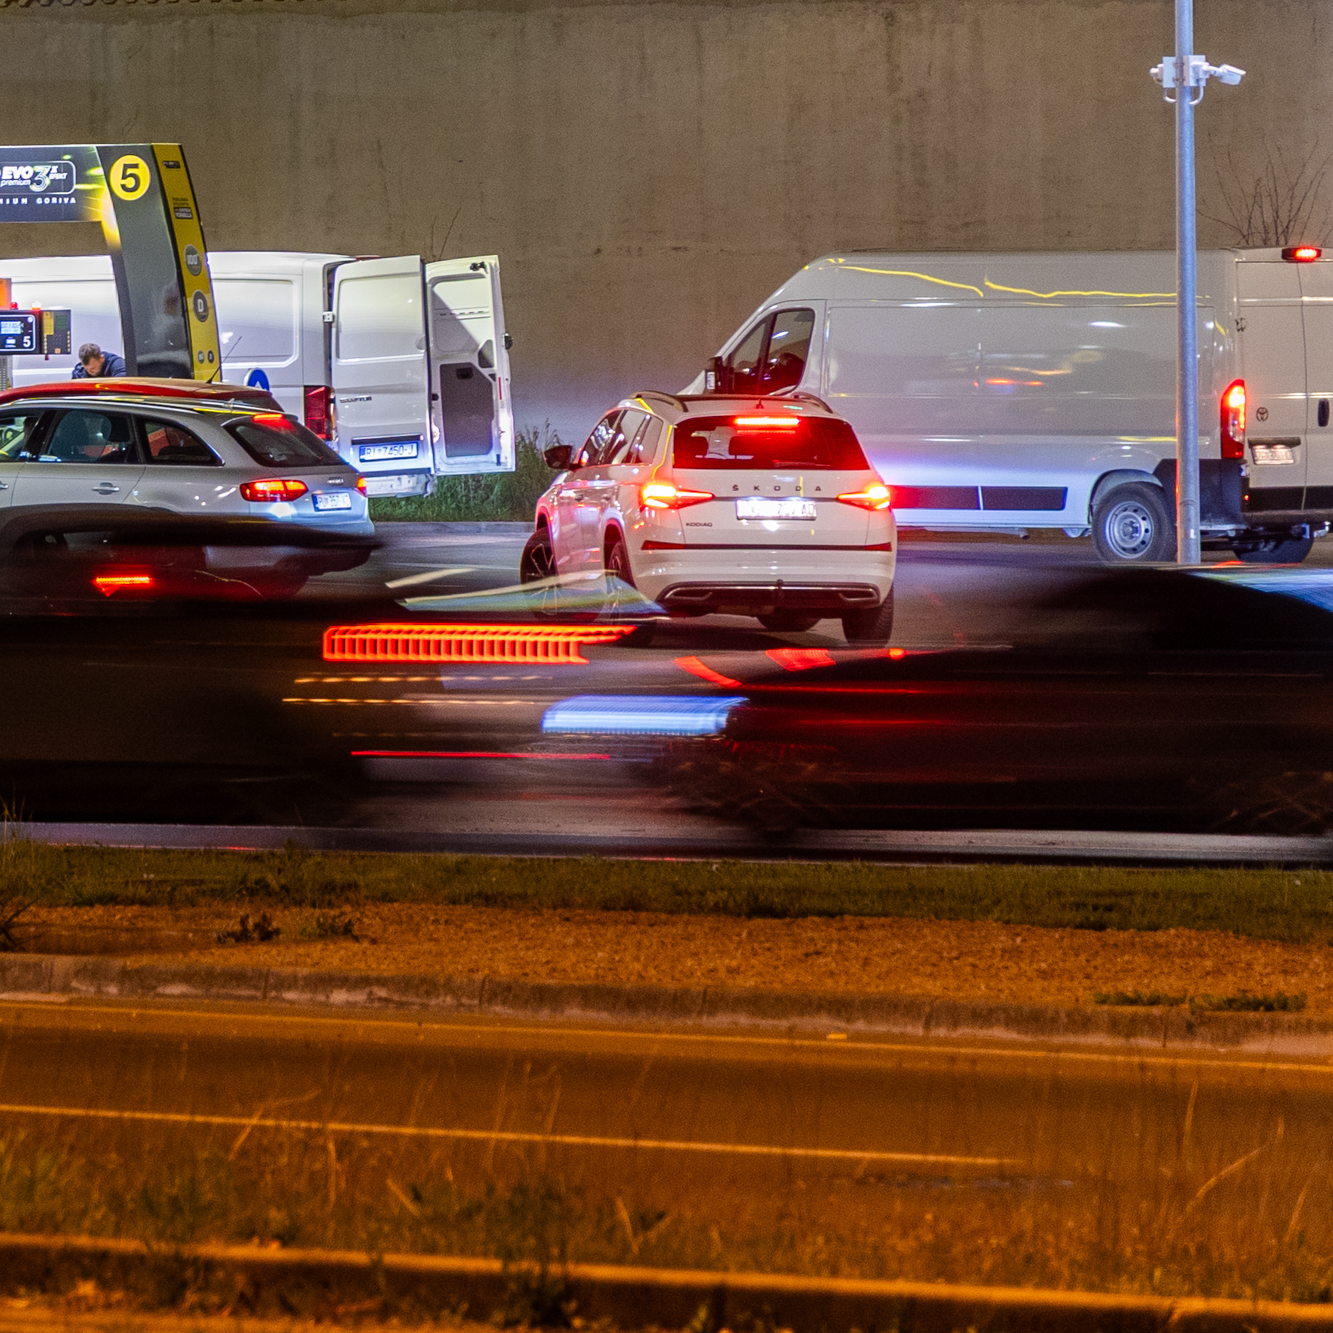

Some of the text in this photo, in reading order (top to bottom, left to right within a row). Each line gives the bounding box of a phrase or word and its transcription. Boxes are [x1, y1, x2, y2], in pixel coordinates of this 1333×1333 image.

[2, 166, 34, 179] EVO
[120, 163, 141, 193] 5
[0, 179, 31, 187] premium
[197, 299, 204, 312] D
[23, 336, 31, 348] 5
